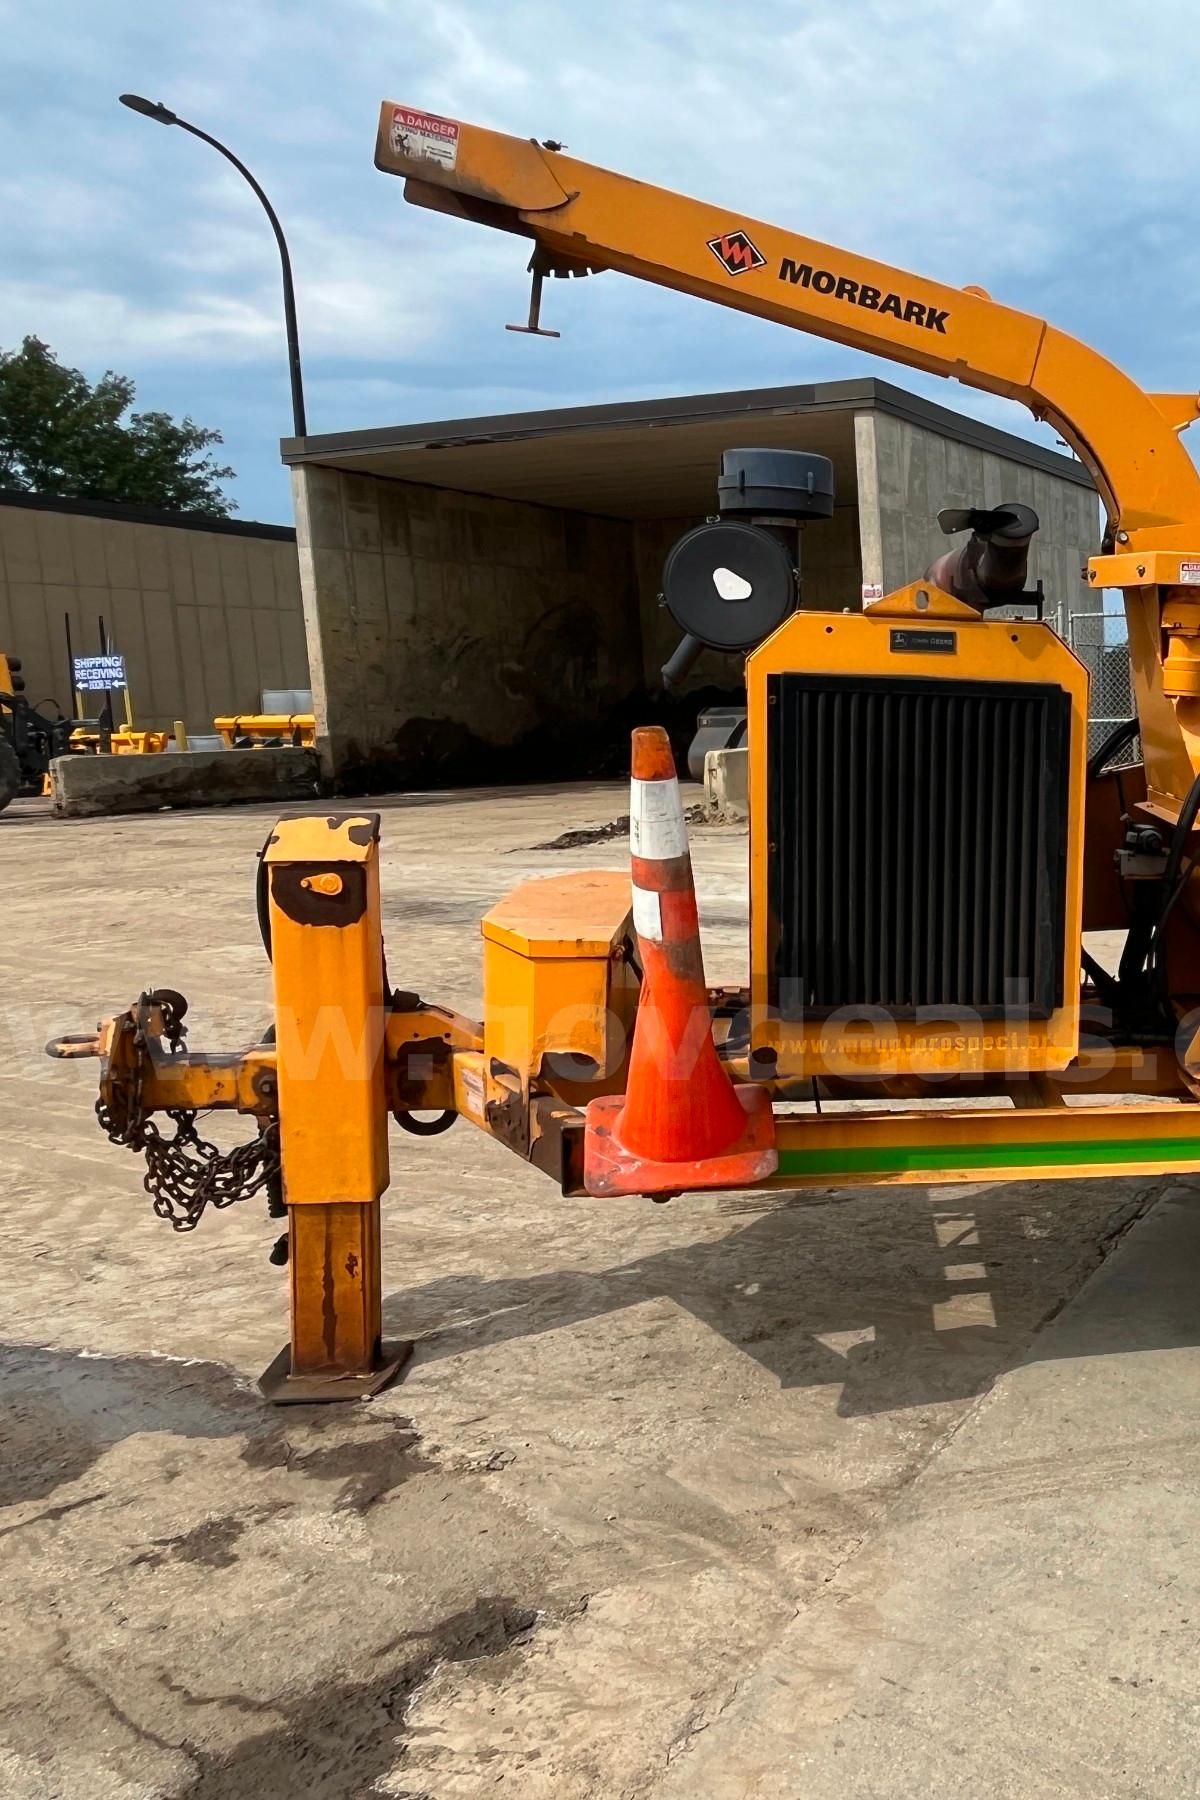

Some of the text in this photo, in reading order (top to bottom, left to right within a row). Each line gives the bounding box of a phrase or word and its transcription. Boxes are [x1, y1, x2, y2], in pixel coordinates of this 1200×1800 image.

[406, 115, 456, 137] DANGER
[778, 257, 950, 334] MORBARK
[74, 667, 123, 680] RECEIVING
